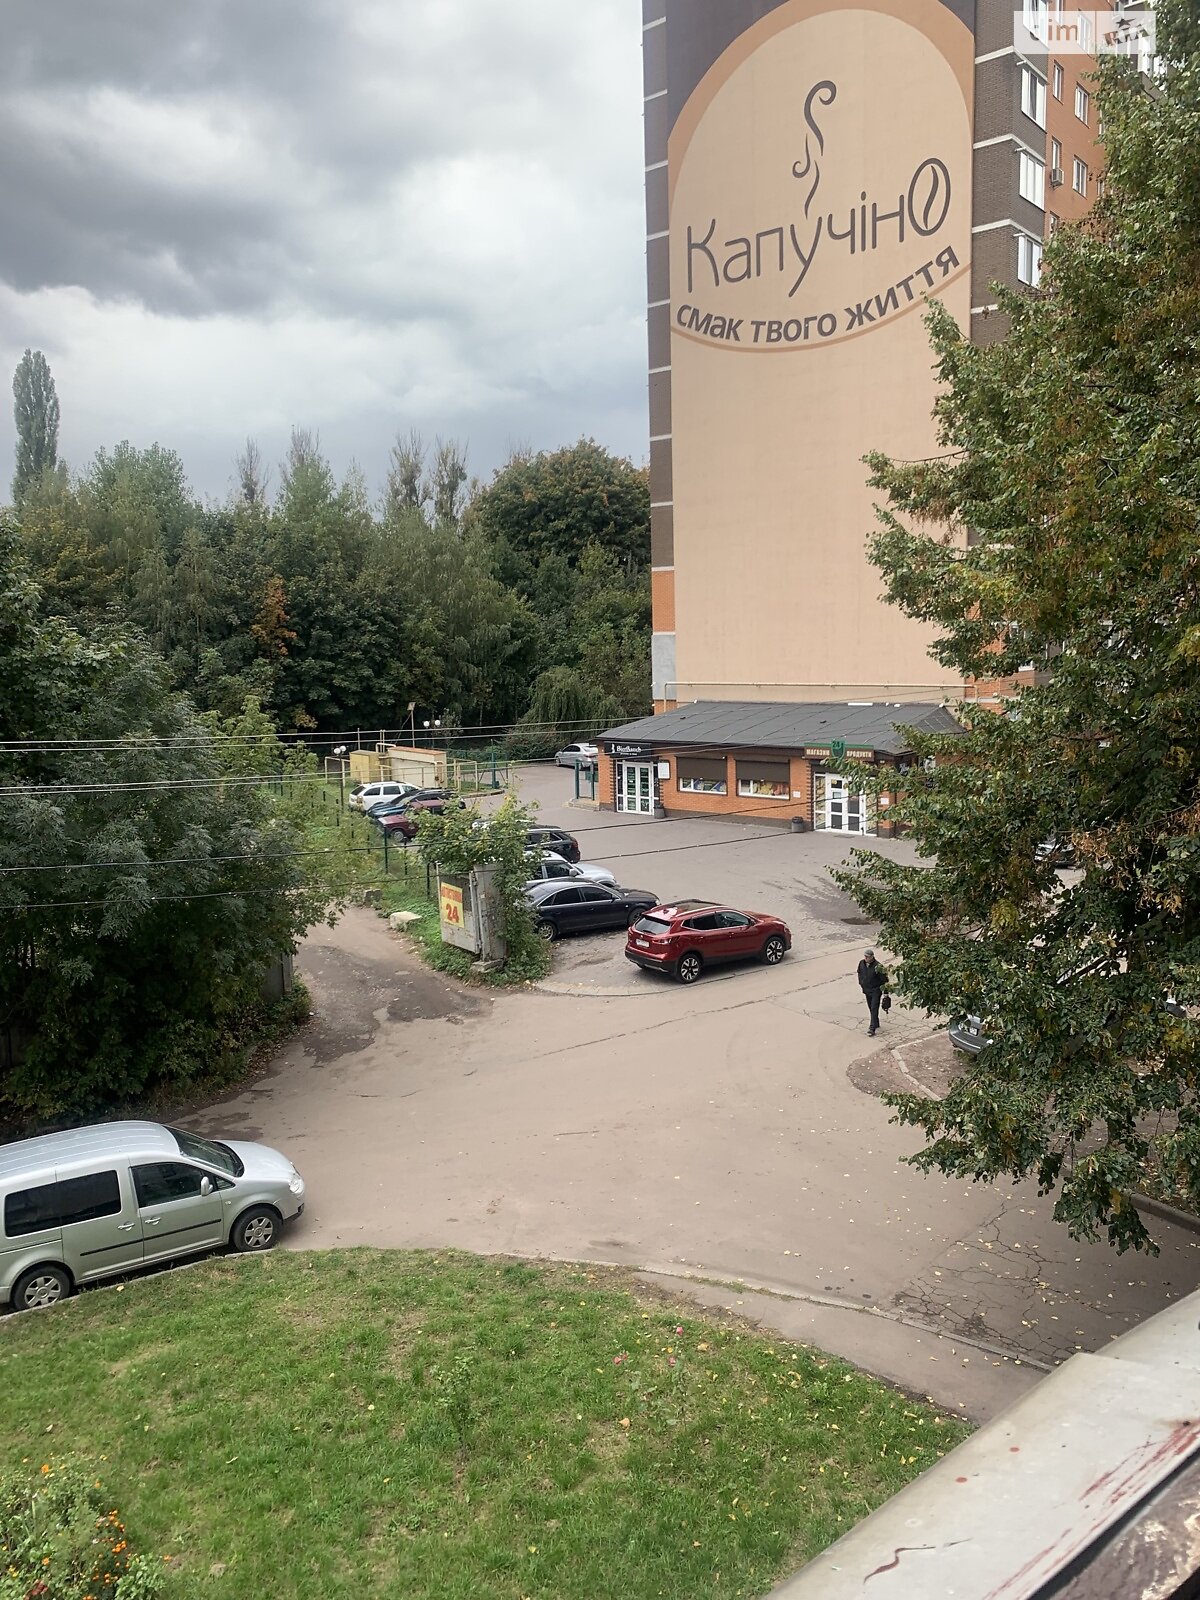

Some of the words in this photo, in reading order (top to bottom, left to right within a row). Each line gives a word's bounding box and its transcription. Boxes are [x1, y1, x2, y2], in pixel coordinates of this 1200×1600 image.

[676, 304, 742, 342] смак
[750, 312, 837, 344] твого
[843, 244, 961, 331] життя
[446, 903, 460, 923] 24
